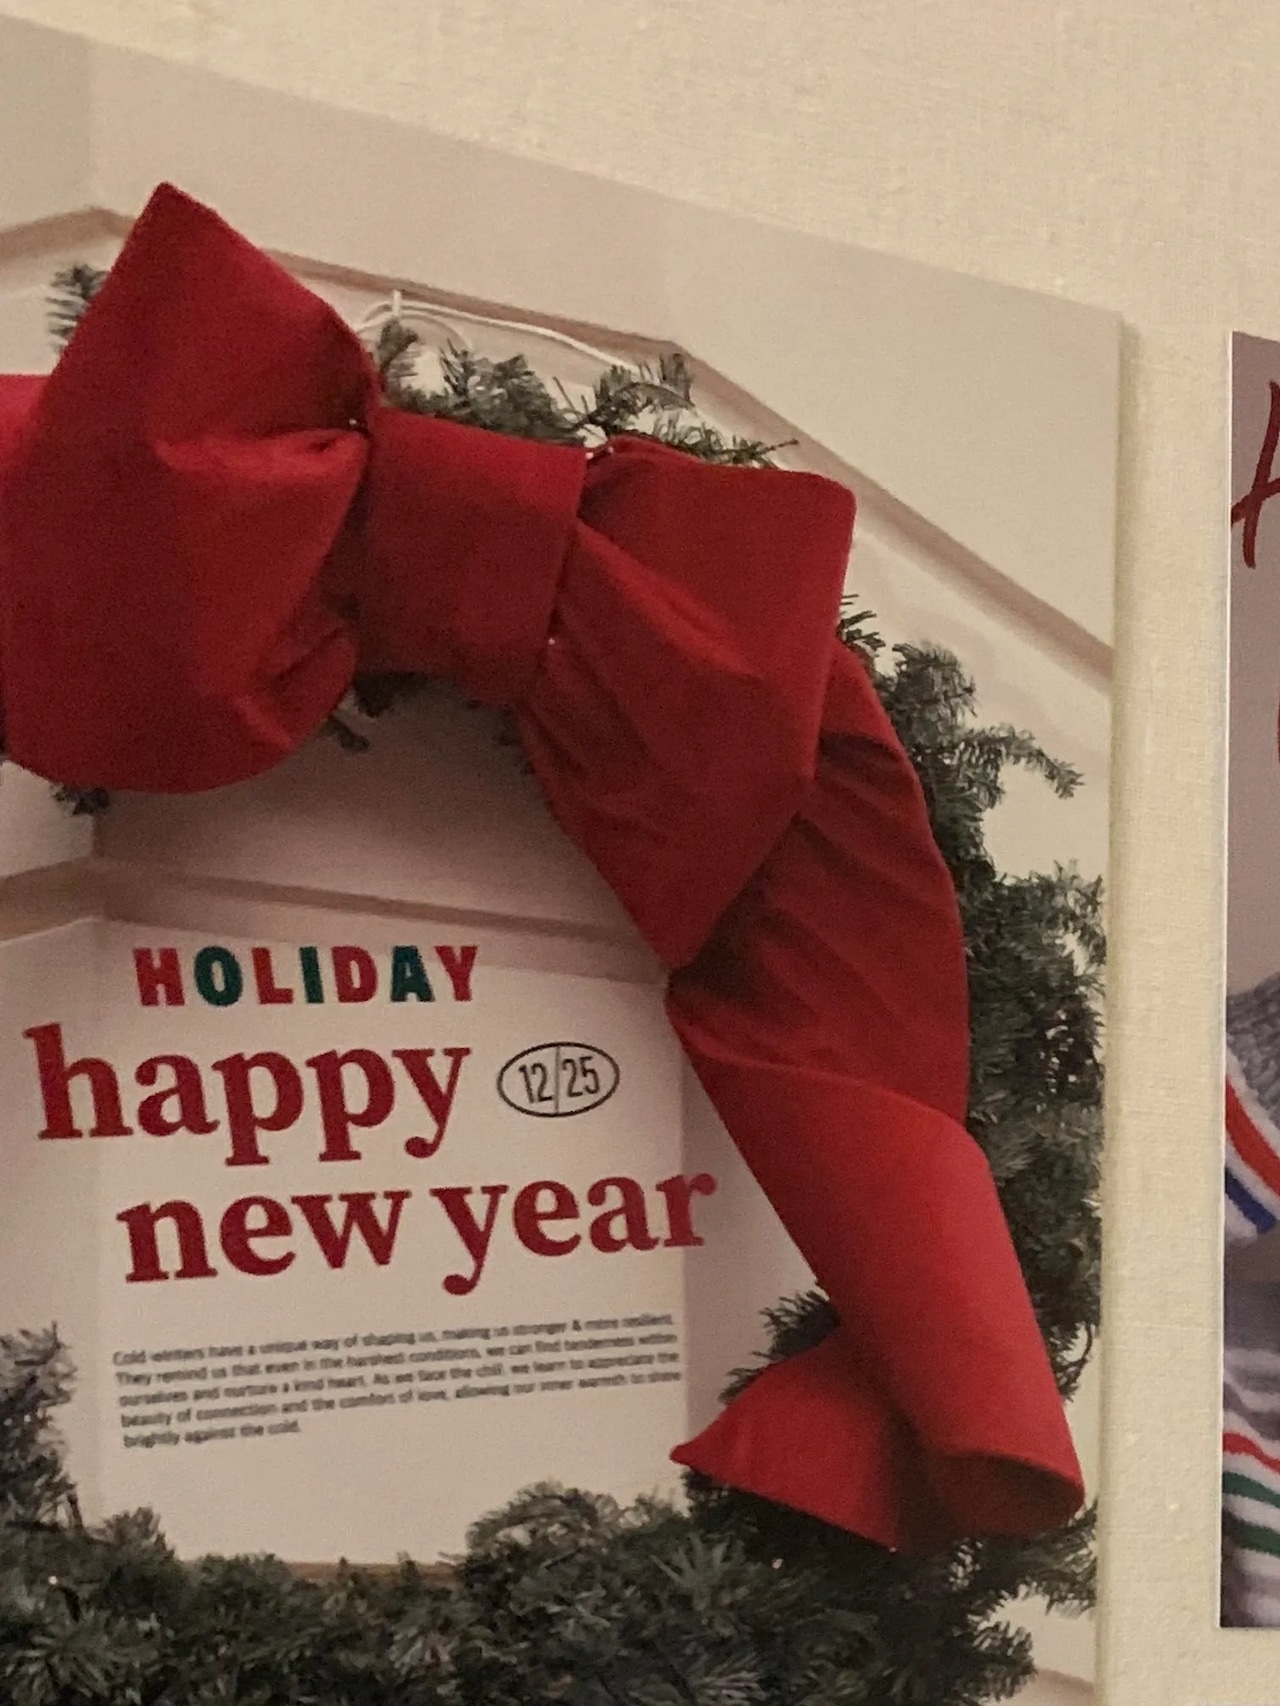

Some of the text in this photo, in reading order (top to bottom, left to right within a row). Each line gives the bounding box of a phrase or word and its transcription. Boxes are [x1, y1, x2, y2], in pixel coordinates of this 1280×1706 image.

[133, 944, 478, 1007] HOLIDAY
[22, 1022, 471, 1167] happy
[117, 1170, 717, 1296] new year
